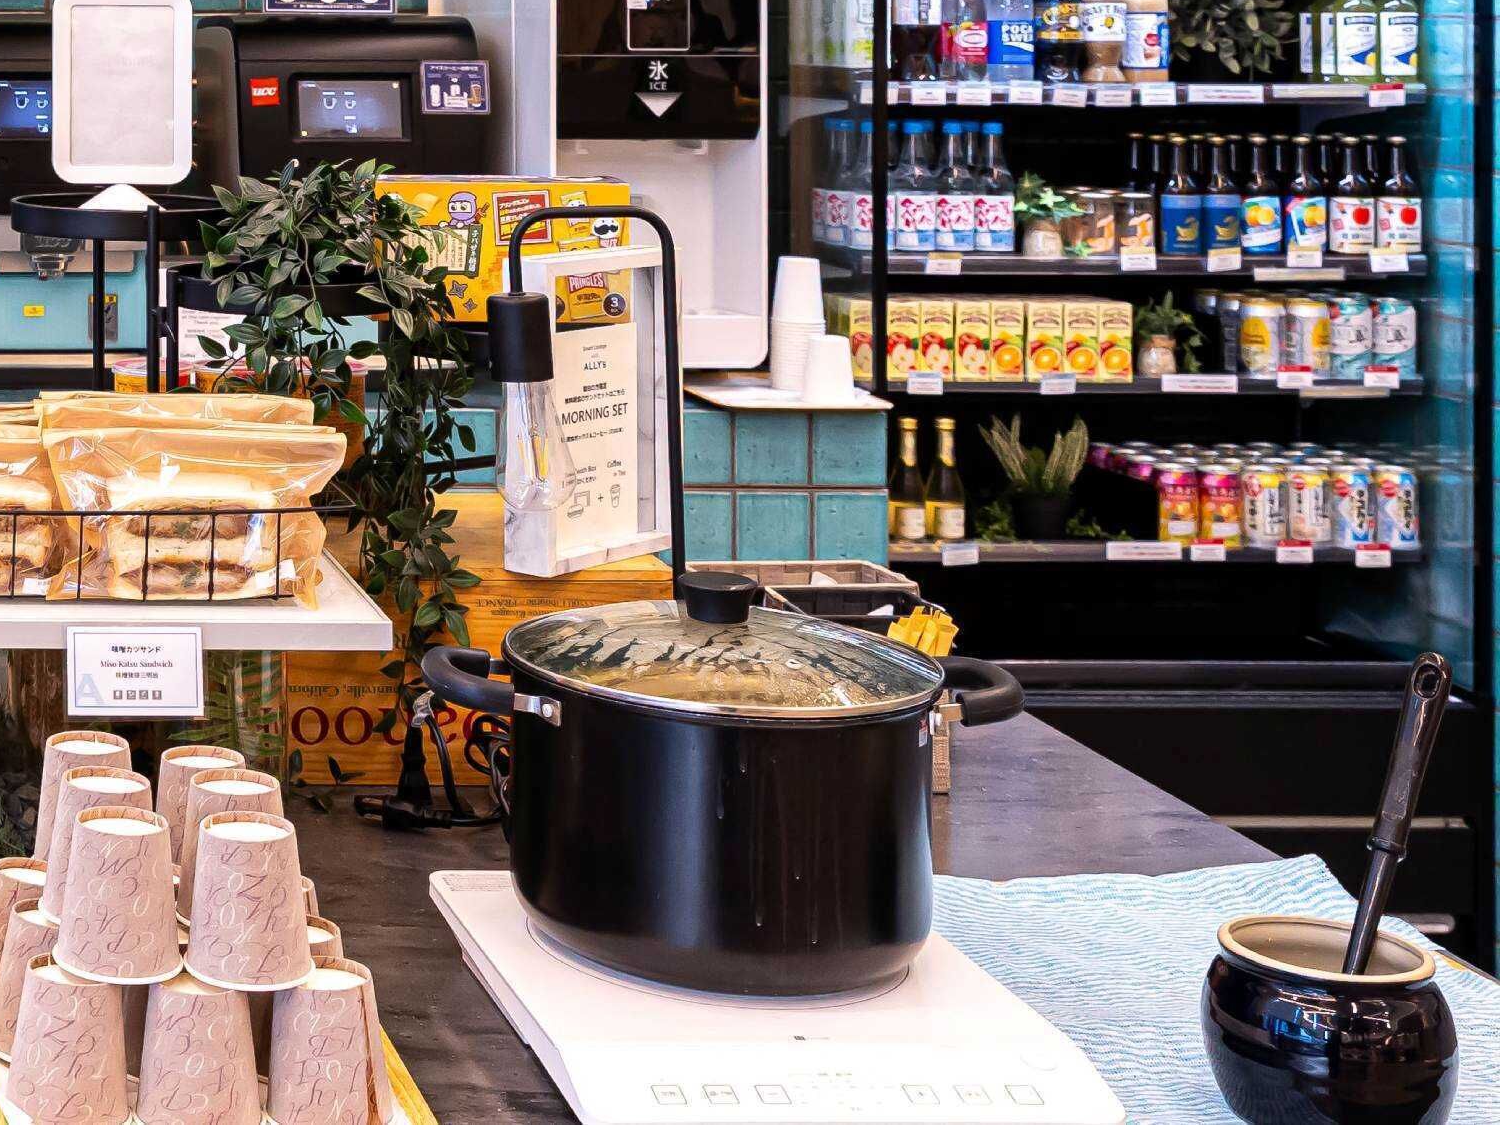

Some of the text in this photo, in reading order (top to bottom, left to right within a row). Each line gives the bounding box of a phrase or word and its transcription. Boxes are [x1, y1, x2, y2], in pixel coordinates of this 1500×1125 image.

[648, 60, 669, 80] 氷
[650, 81, 668, 91] ICE
[569, 272, 605, 292] PRINGLES
[610, 297, 619, 308] 3
[561, 403, 628, 426] MORNING SET
[100, 660, 173, 668] Miso Katsu Sandwich
